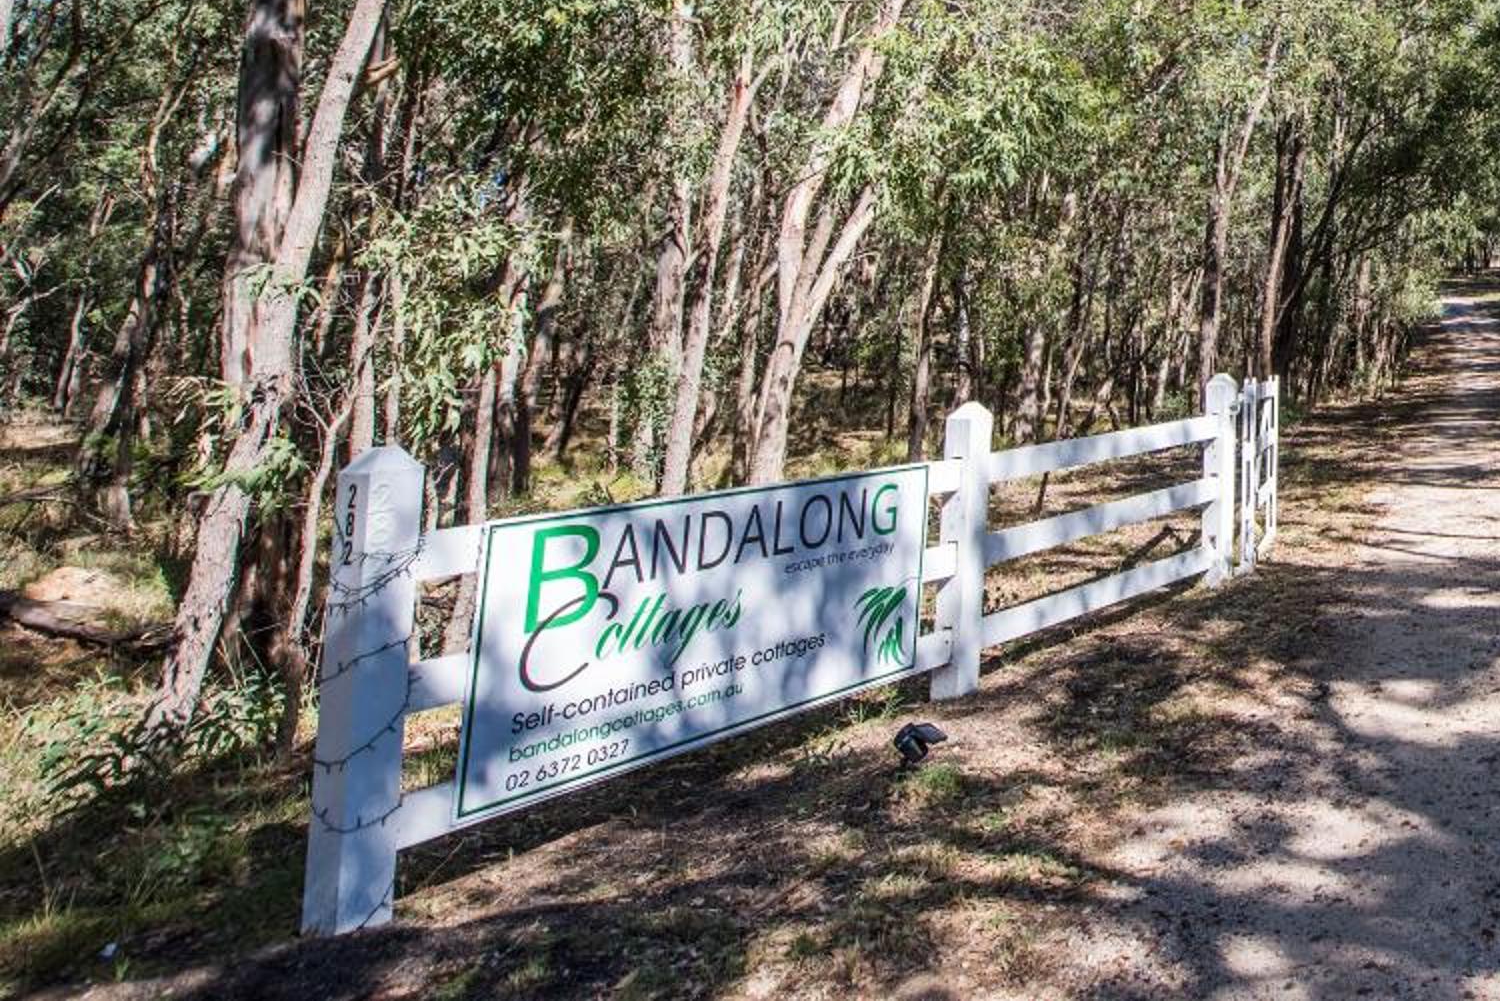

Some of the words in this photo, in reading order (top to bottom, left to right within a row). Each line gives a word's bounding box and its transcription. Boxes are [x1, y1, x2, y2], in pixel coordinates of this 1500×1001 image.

[344, 483, 357, 566] 282
[524, 483, 898, 634] BANDALONG
[784, 555, 825, 575] escape
[827, 552, 845, 566] the
[847, 543, 896, 562] everyday
[519, 588, 743, 693] Cottages
[508, 683, 743, 763] bandalongcottages.com.au
[511, 671, 676, 735] Self-contained
[681, 654, 747, 690] private
[751, 632, 826, 666] cottages
[506, 770, 529, 793] 02
[535, 756, 581, 783] 6372
[587, 739, 630, 766] 0327
